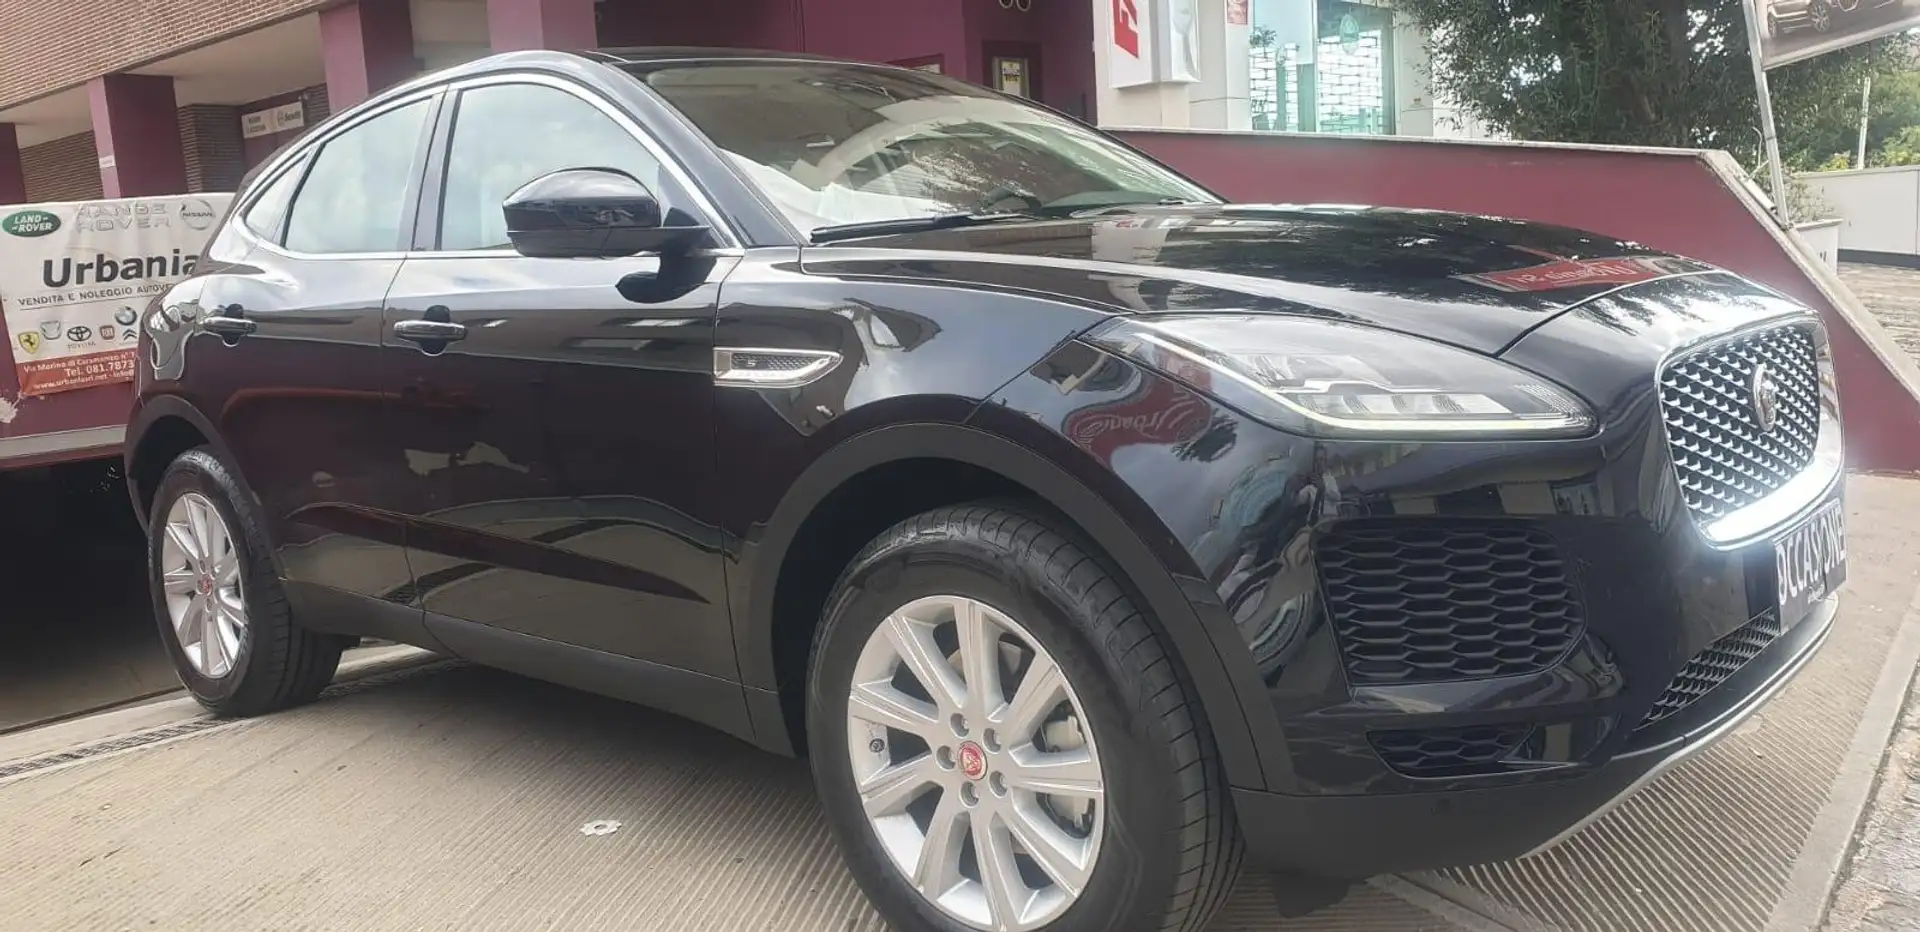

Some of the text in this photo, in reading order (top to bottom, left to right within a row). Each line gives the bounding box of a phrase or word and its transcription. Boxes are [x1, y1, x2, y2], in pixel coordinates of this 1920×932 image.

[43, 248, 199, 288] Urbania
[18, 294, 64, 306] VENDITA
[80, 287, 133, 300] NOLEGGIO
